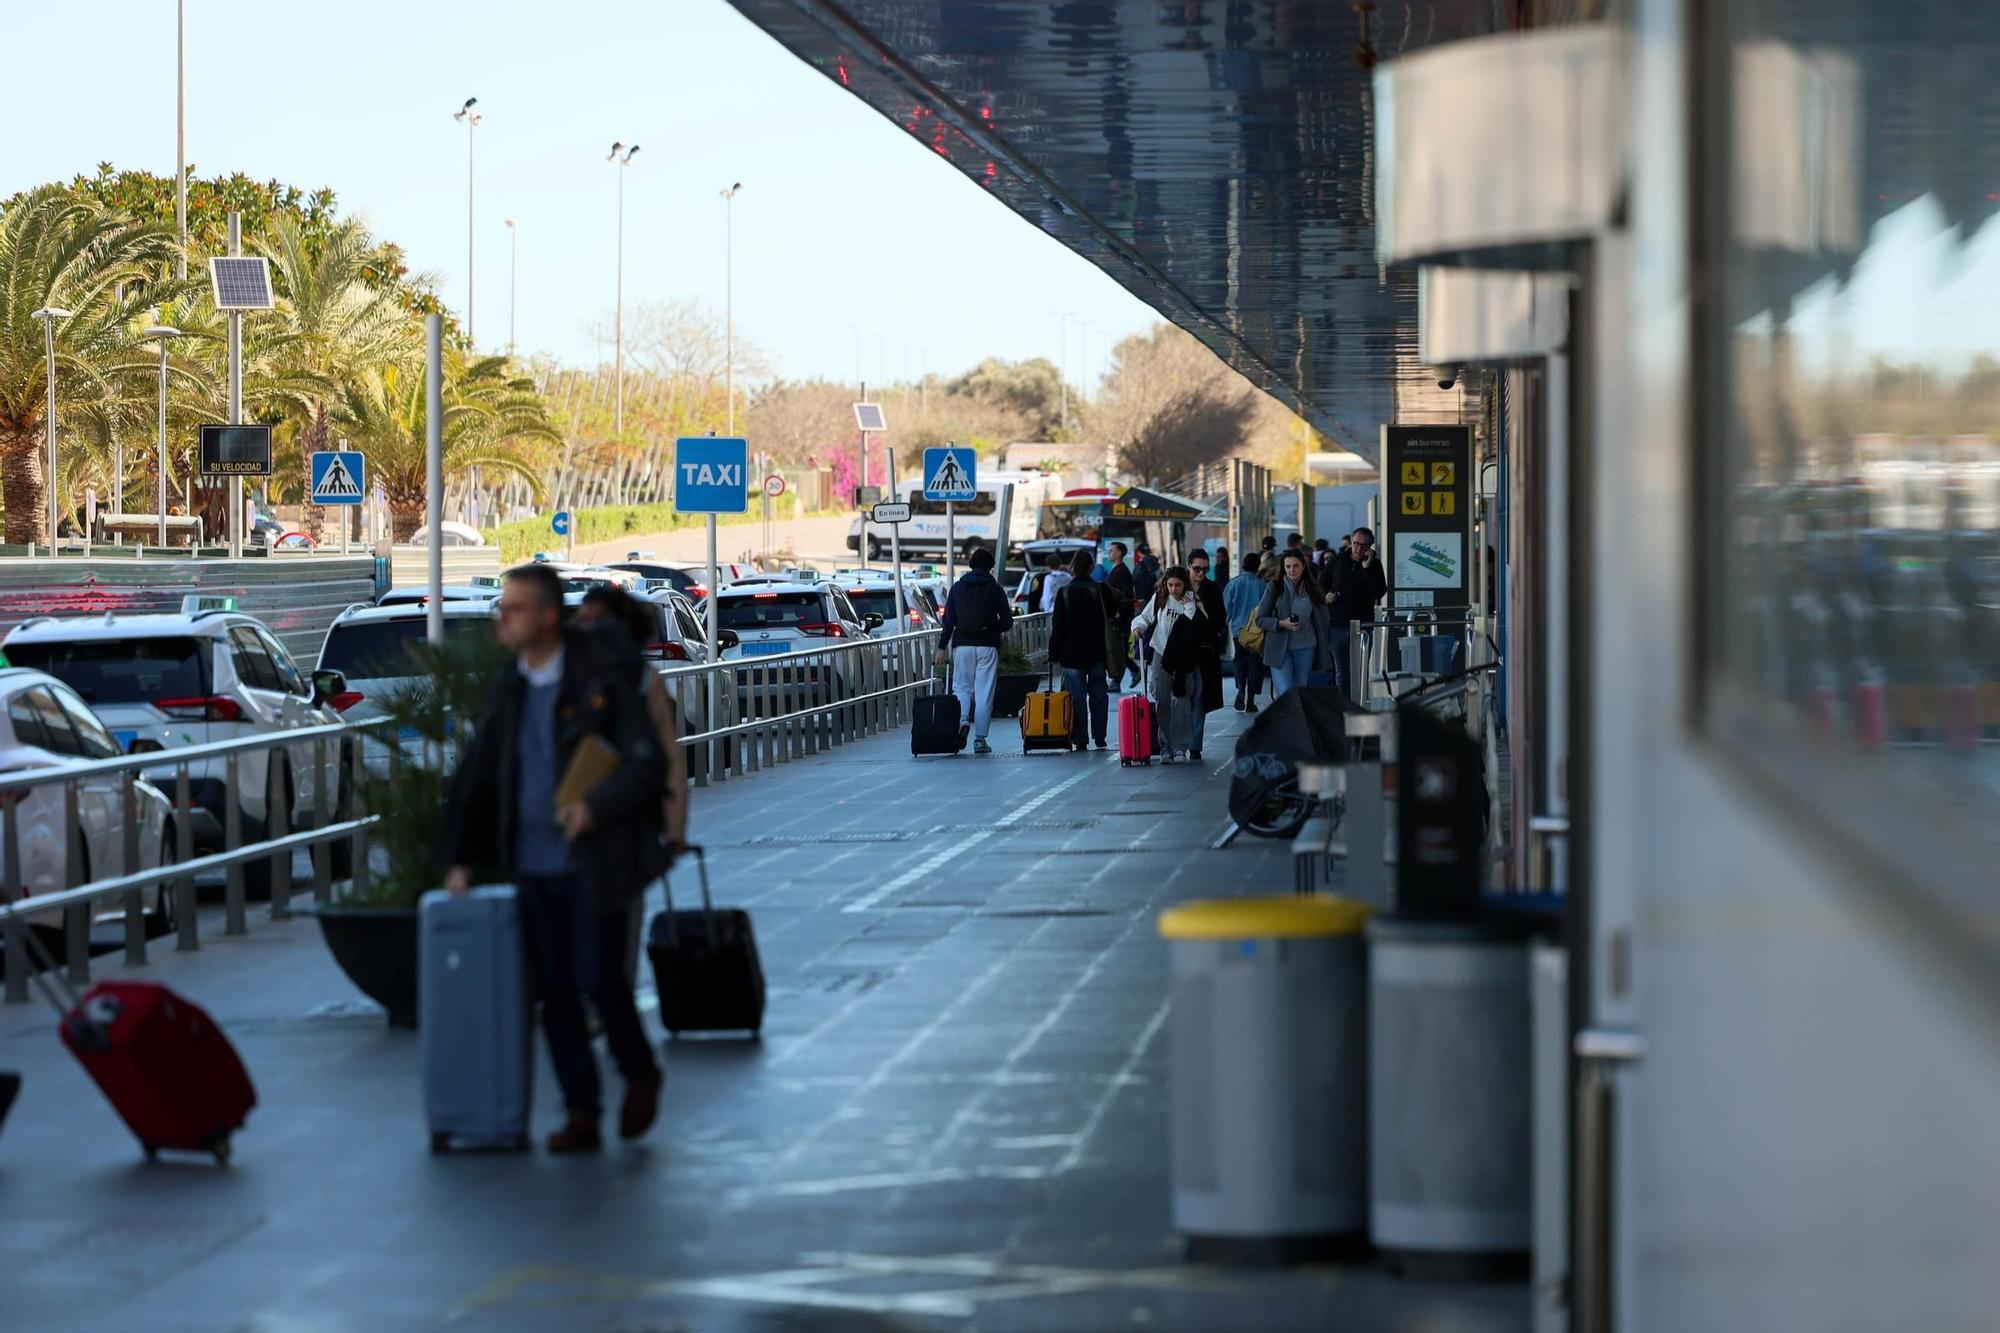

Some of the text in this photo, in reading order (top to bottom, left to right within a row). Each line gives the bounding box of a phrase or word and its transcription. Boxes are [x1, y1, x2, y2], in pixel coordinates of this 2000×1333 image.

[1407, 438, 1419, 447] sin
[210, 462, 262, 471] SU VELOCIDAD
[681, 463, 741, 487] TAXI
[769, 481, 781, 491] 30
[879, 510, 888, 518] En
[1074, 514, 1104, 526] alsa
